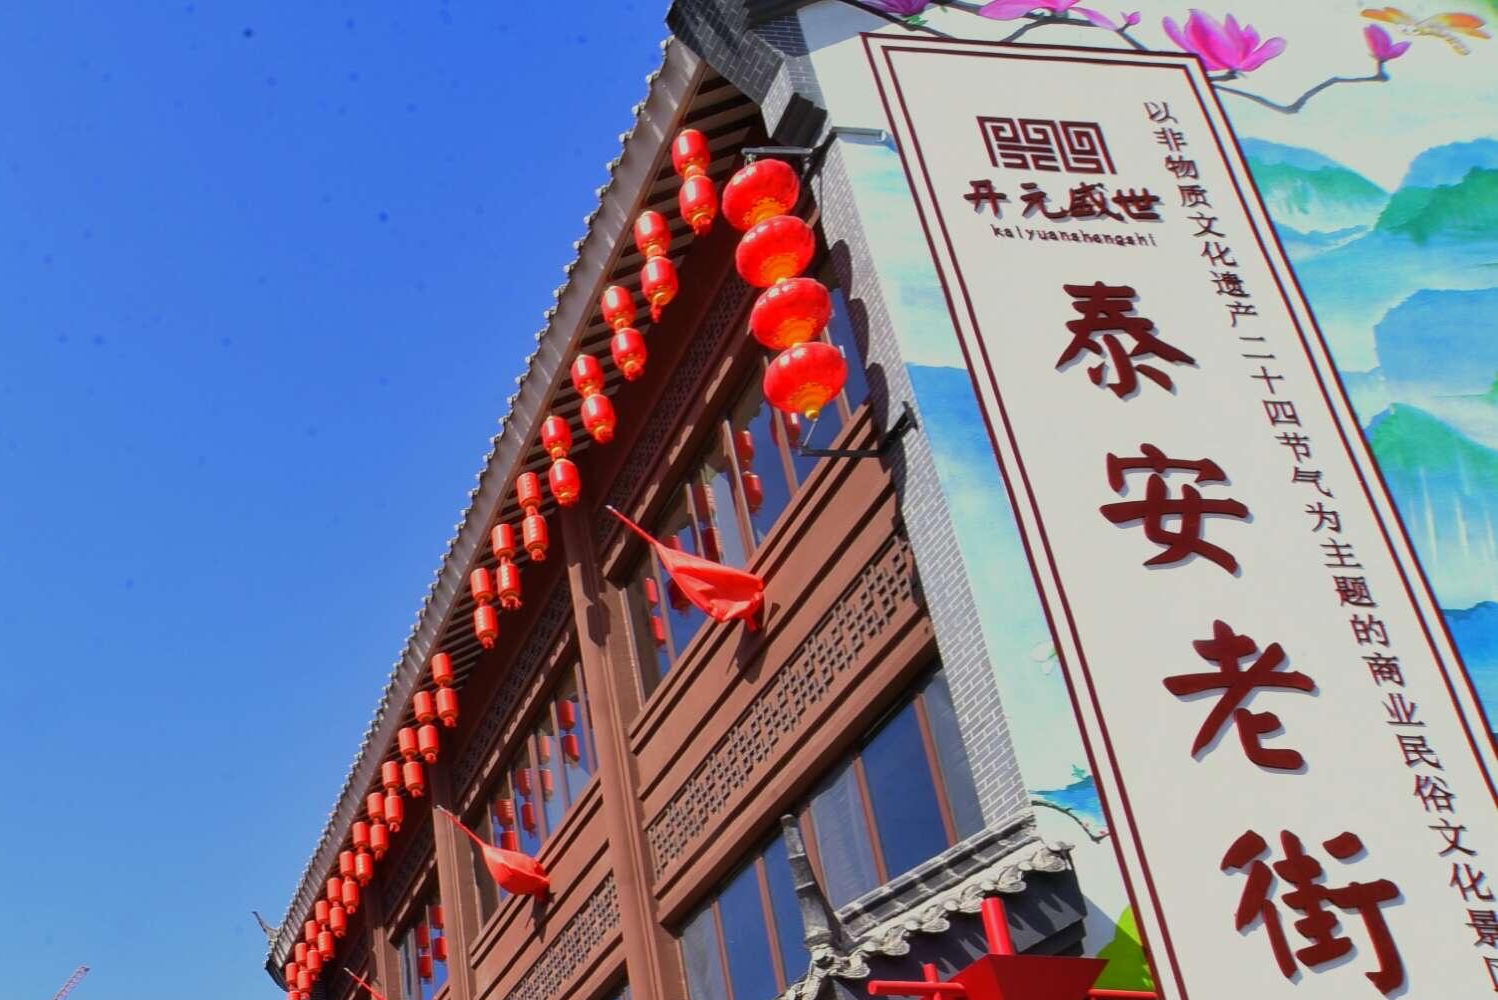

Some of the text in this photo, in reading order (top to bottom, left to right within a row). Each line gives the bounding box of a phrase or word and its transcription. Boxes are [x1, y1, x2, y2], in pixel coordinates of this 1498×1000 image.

[990, 223, 1158, 247] kaiyuanshengshi
[1056, 281, 1404, 997] 泰安老街
